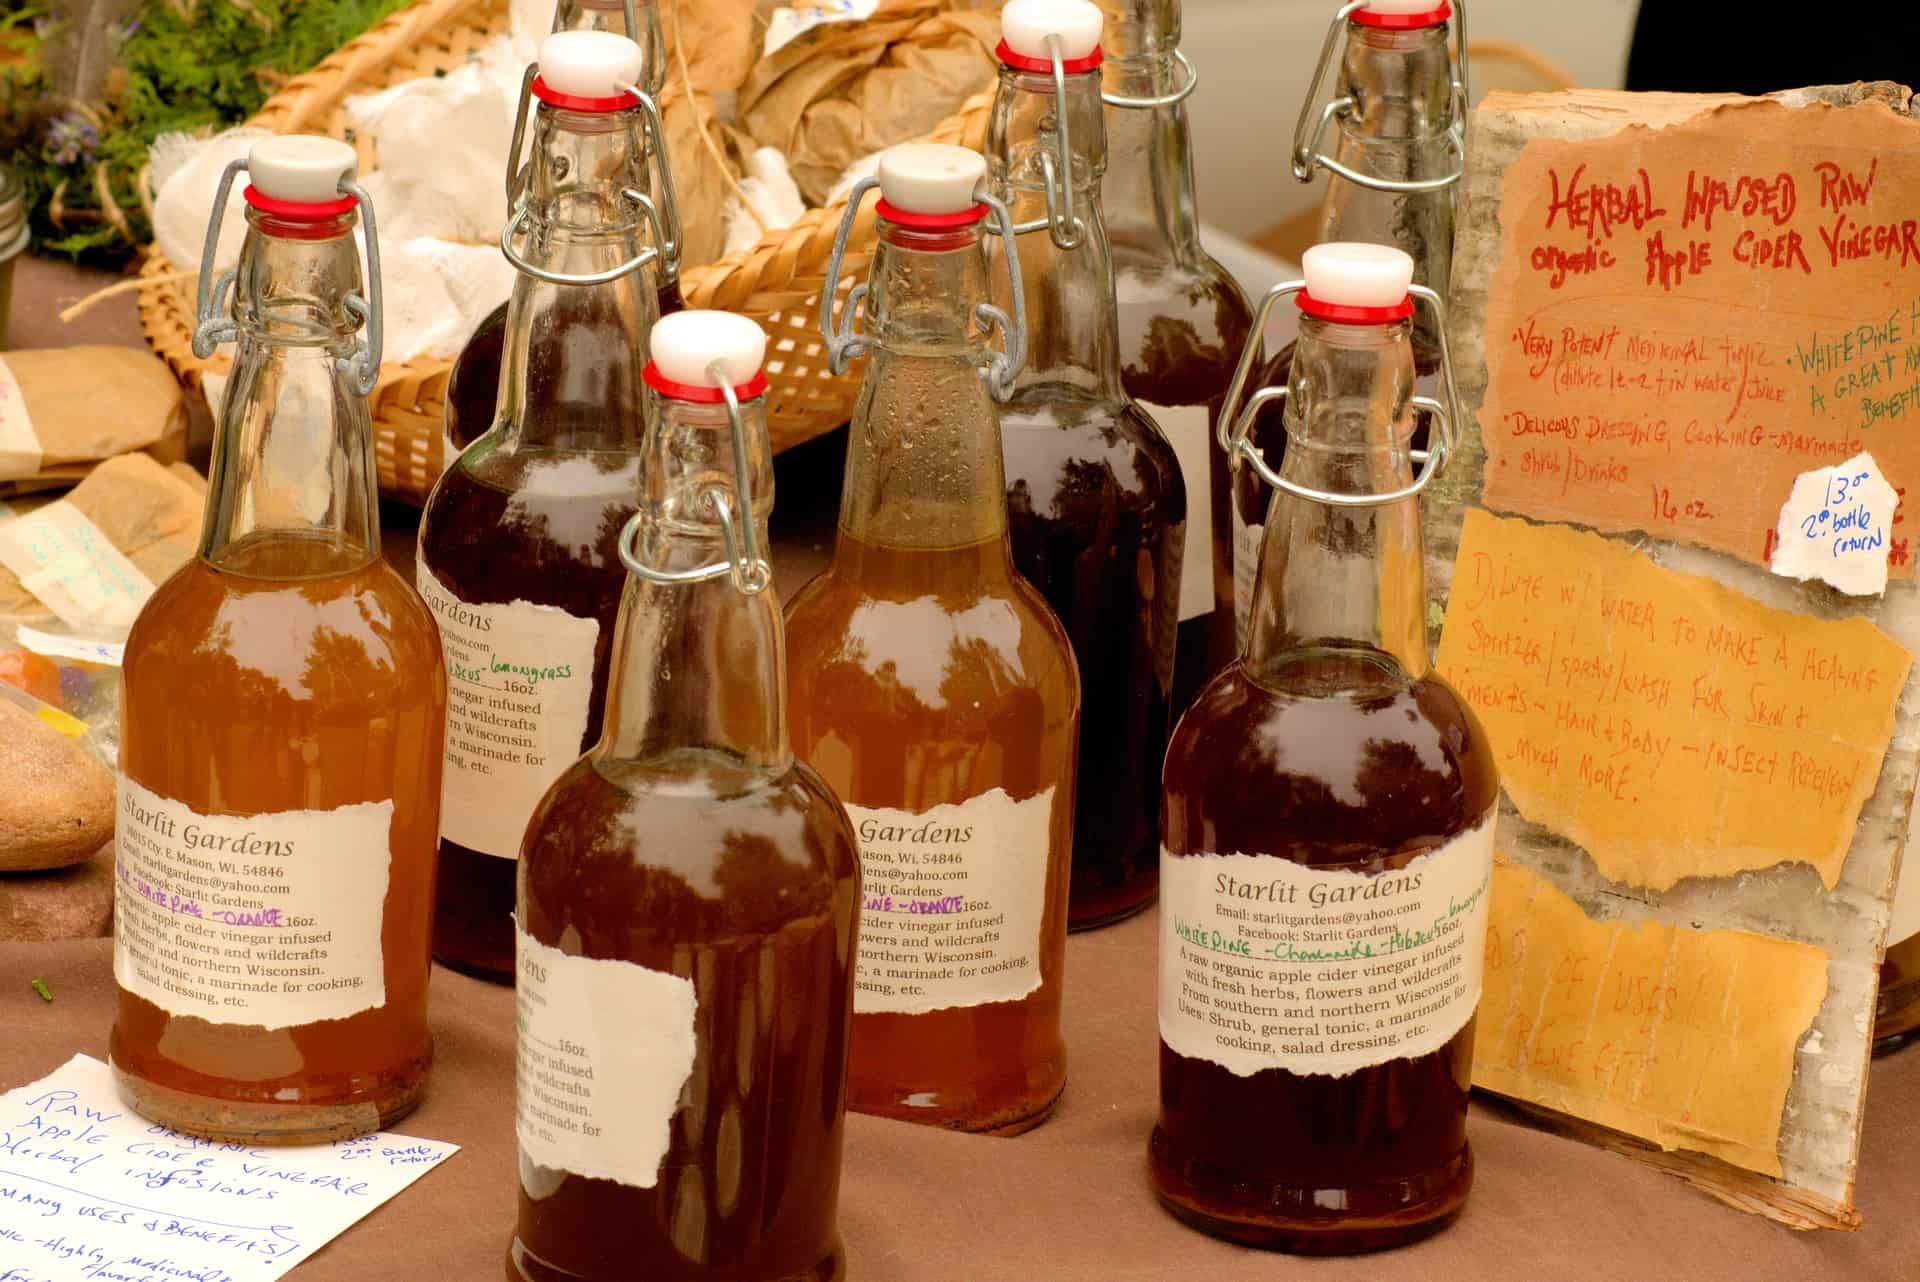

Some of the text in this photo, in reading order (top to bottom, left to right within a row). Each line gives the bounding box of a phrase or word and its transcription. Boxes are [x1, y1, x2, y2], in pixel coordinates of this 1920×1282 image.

[1546, 157, 1877, 239] HERBAL INFUSED RAW
[503, 681, 538, 695] 16oz.
[488, 697, 541, 715] infused
[470, 710, 537, 731] wildcrafts
[465, 723, 536, 749] Wisconsin.
[459, 739, 546, 766] marinade for
[471, 762, 493, 776] etc.
[124, 793, 176, 839] Starlit
[183, 824, 295, 857] Gardens
[859, 818, 974, 843] Gardens
[177, 851, 215, 872] Mason,
[242, 865, 284, 878] 54846
[923, 854, 962, 865] 54846
[143, 856, 290, 894] starlitgardens@yahoo.com
[175, 885, 208, 902] Starlit
[212, 894, 264, 909] Gardens
[890, 884, 943, 896] Gardens
[1216, 873, 1423, 908] Starlit Gardens
[899, 912, 1004, 933] vinegar infused
[1216, 902, 1421, 926] Email: starlitgardens@yahoo.com
[152, 909, 332, 946] apple cider vinegar infused
[902, 931, 1000, 948] and wildcrafts
[1238, 922, 1398, 941] Facebook: Starlit Gardens
[175, 935, 220, 955] flowers
[224, 947, 251, 960] and
[256, 948, 328, 961] wildcrafts
[924, 948, 997, 964] Wisconsin.
[1180, 946, 1186, 959] A
[1188, 950, 1209, 967] raw
[1212, 961, 1264, 979] organic
[1269, 969, 1311, 984] apple
[1317, 967, 1358, 981] cider
[1363, 957, 1417, 976] vinegar
[1422, 932, 1464, 962] infused
[160, 947, 324, 977] and northern Wisconsin.
[873, 968, 881, 976] a
[886, 967, 953, 979] marinade
[959, 966, 977, 977] for
[161, 962, 193, 983] tonic,
[210, 977, 278, 992] marinade
[283, 981, 303, 993] for
[900, 982, 926, 995] etc.
[1186, 954, 1462, 1001] with fresh herbs, flowers and wildcrafts
[163, 980, 219, 1006] dressing,
[223, 998, 249, 1007] etc.
[1182, 975, 1461, 1018] From southern and northern Wisconsin.
[1178, 983, 1467, 1036] Uses: Shrub, general tonic, a marinade for
[1215, 1024, 1430, 1054] cooking, salad dressing, etc.
[548, 1057, 593, 1080] infused
[26, 1091, 122, 1121] RAW
[534, 1086, 592, 1117] Wisconsin.
[582, 1121, 602, 1137] for
